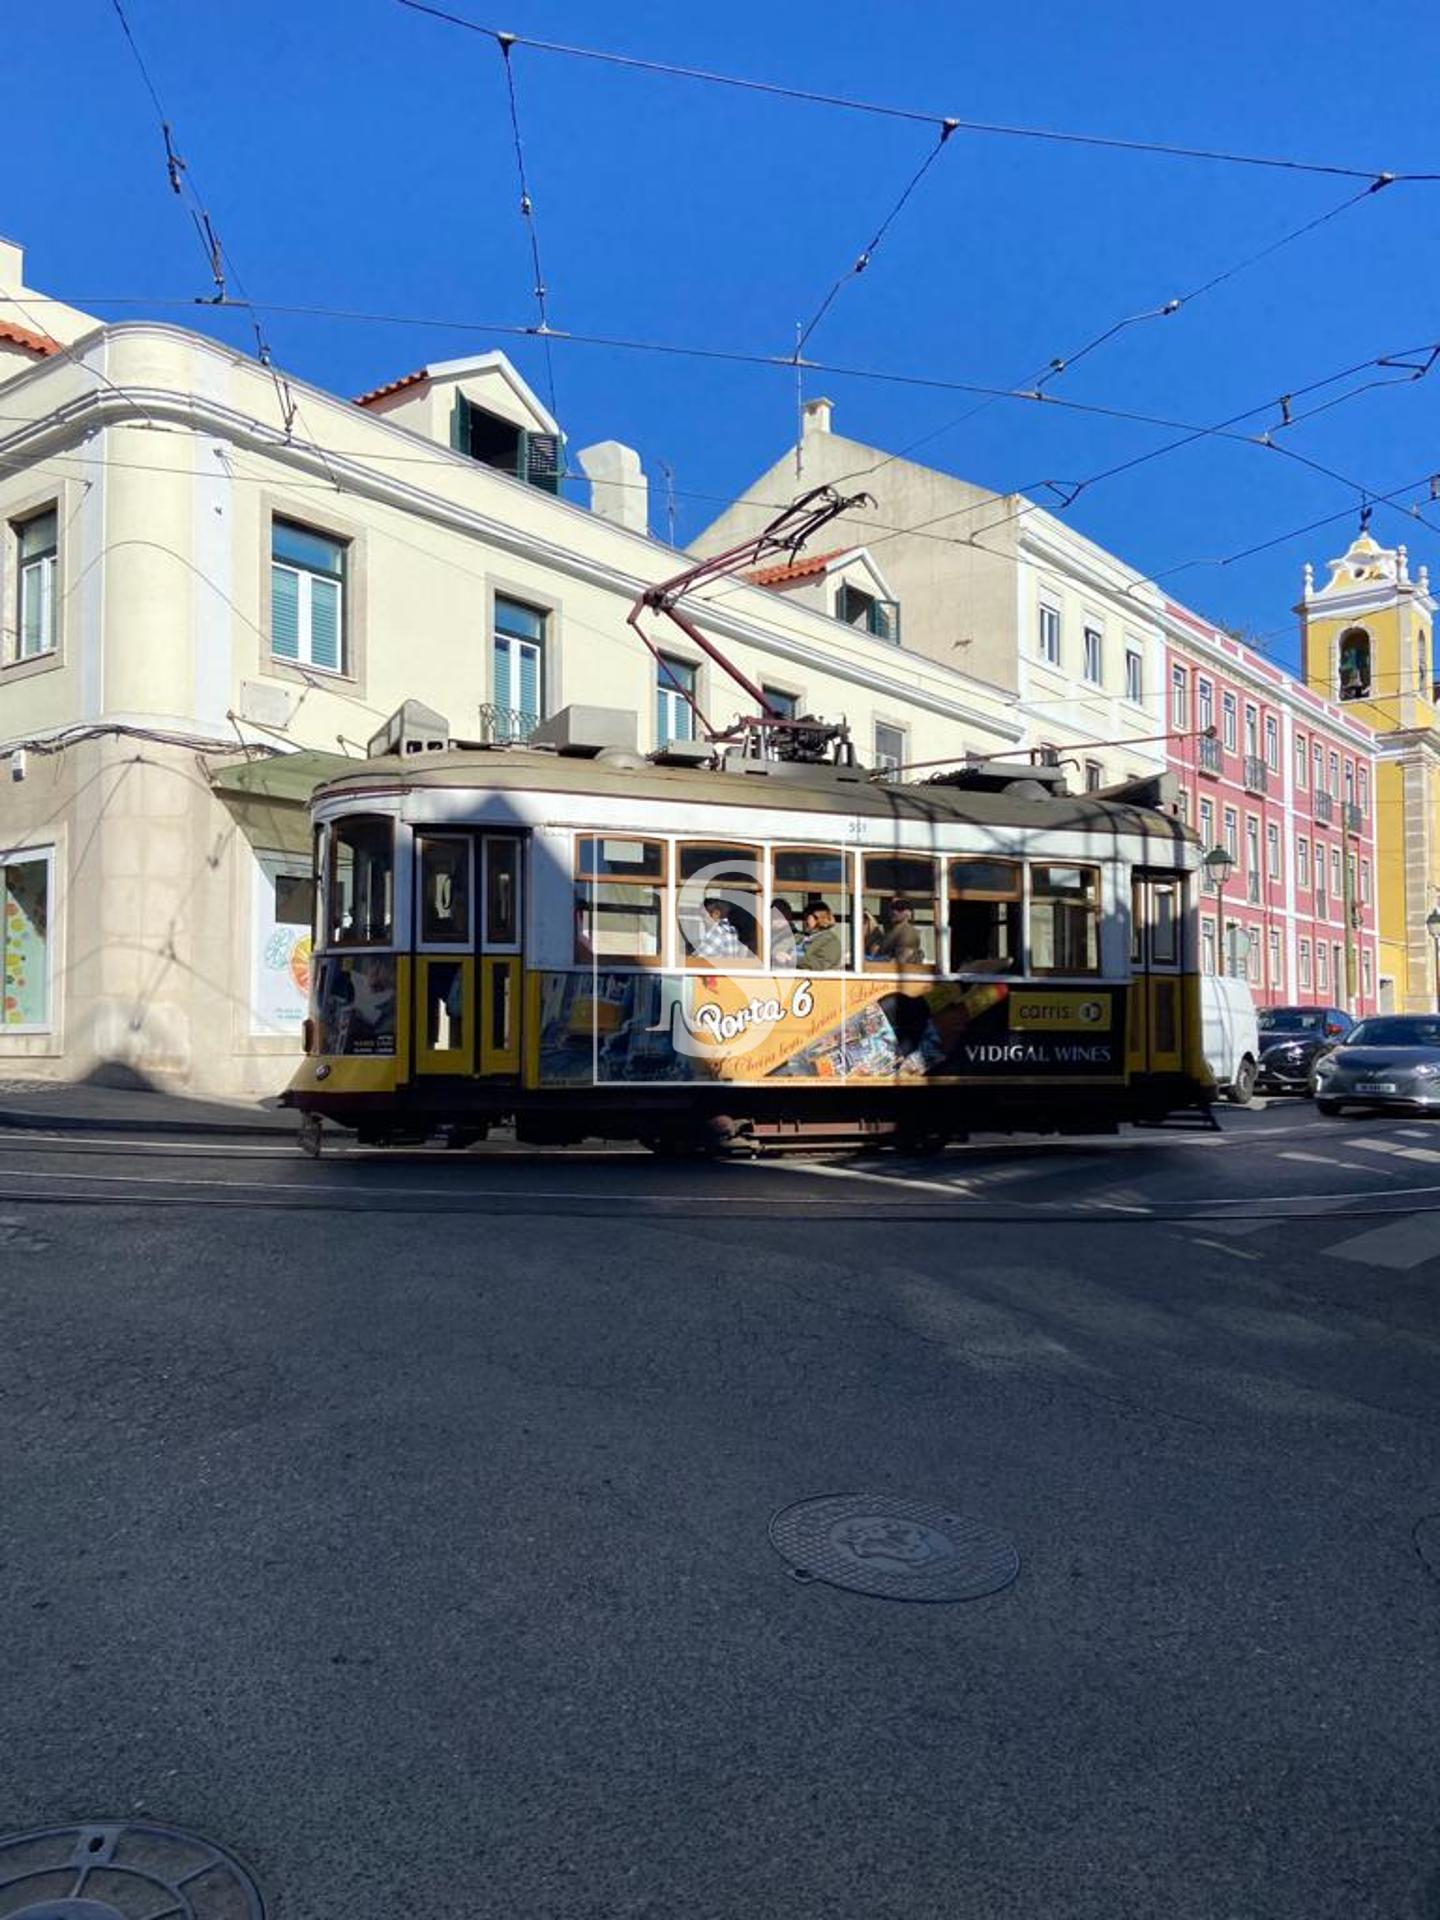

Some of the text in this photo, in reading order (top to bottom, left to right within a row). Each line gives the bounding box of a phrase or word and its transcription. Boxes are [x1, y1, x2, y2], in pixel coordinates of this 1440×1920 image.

[696, 977, 815, 1045] Porta 6
[965, 1045, 1111, 1062] VIDIGAL WINES
